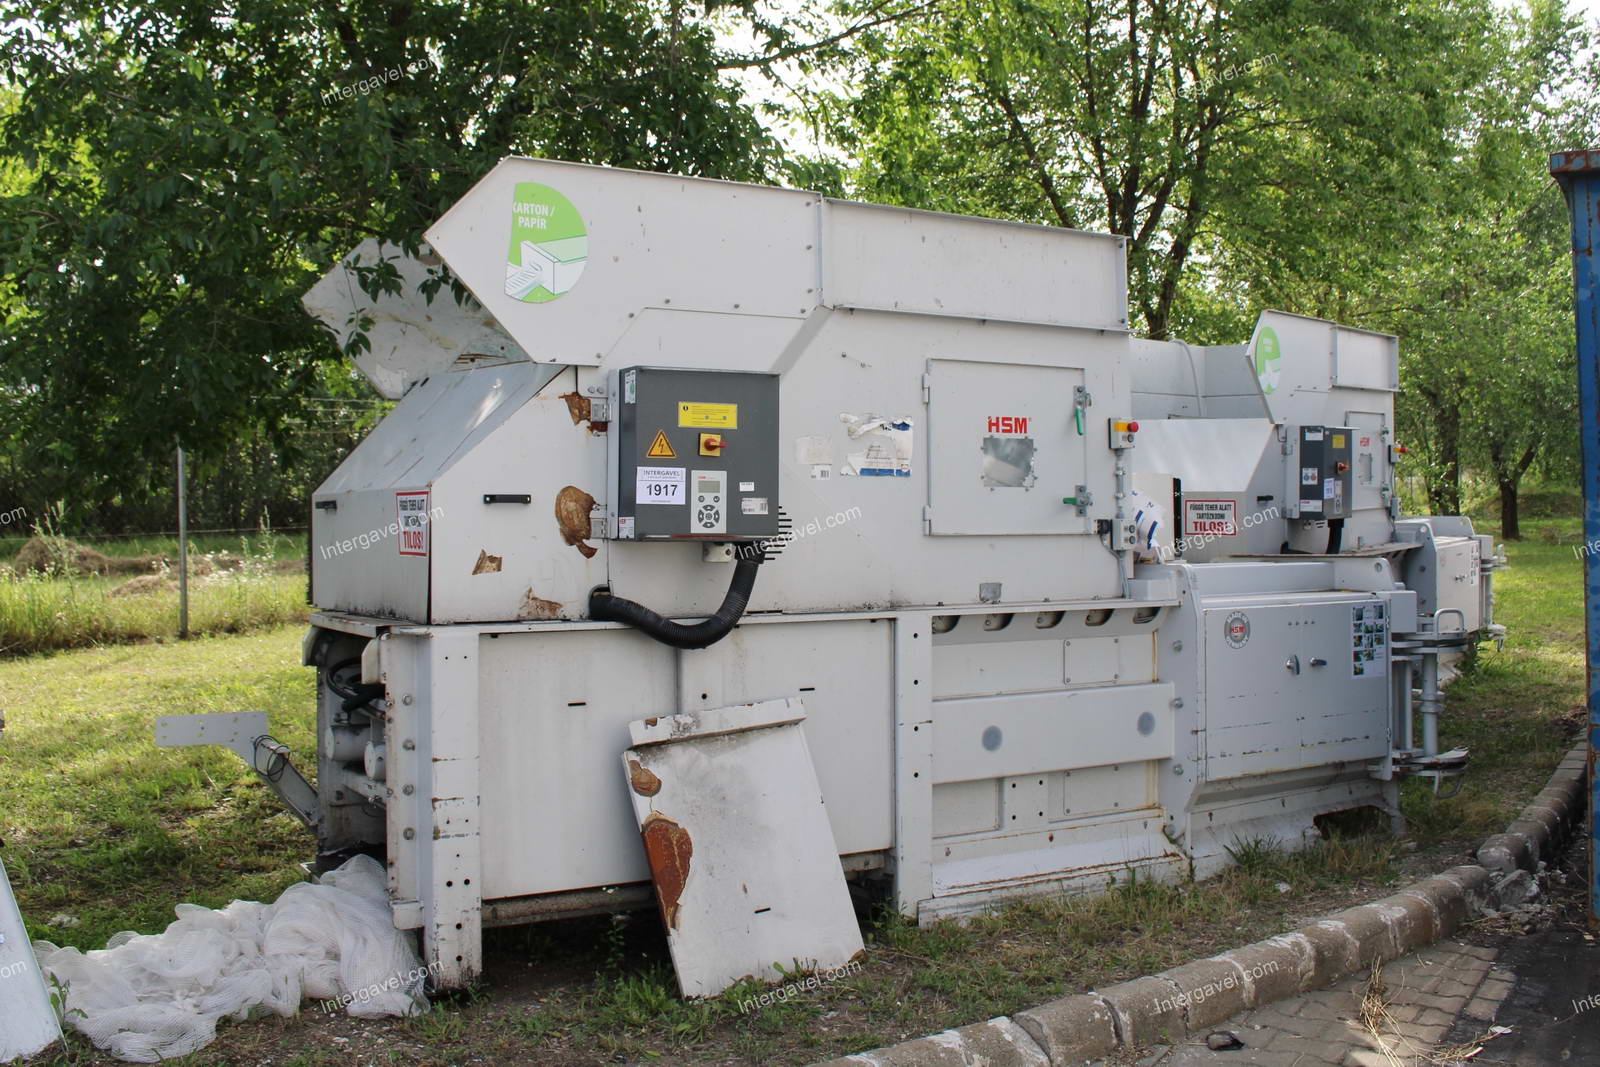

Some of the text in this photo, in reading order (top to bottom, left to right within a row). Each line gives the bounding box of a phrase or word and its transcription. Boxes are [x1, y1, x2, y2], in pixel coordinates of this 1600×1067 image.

[987, 416, 1027, 434] HSM
[646, 484, 678, 496] 1917
[403, 530, 424, 550] TILOS!
